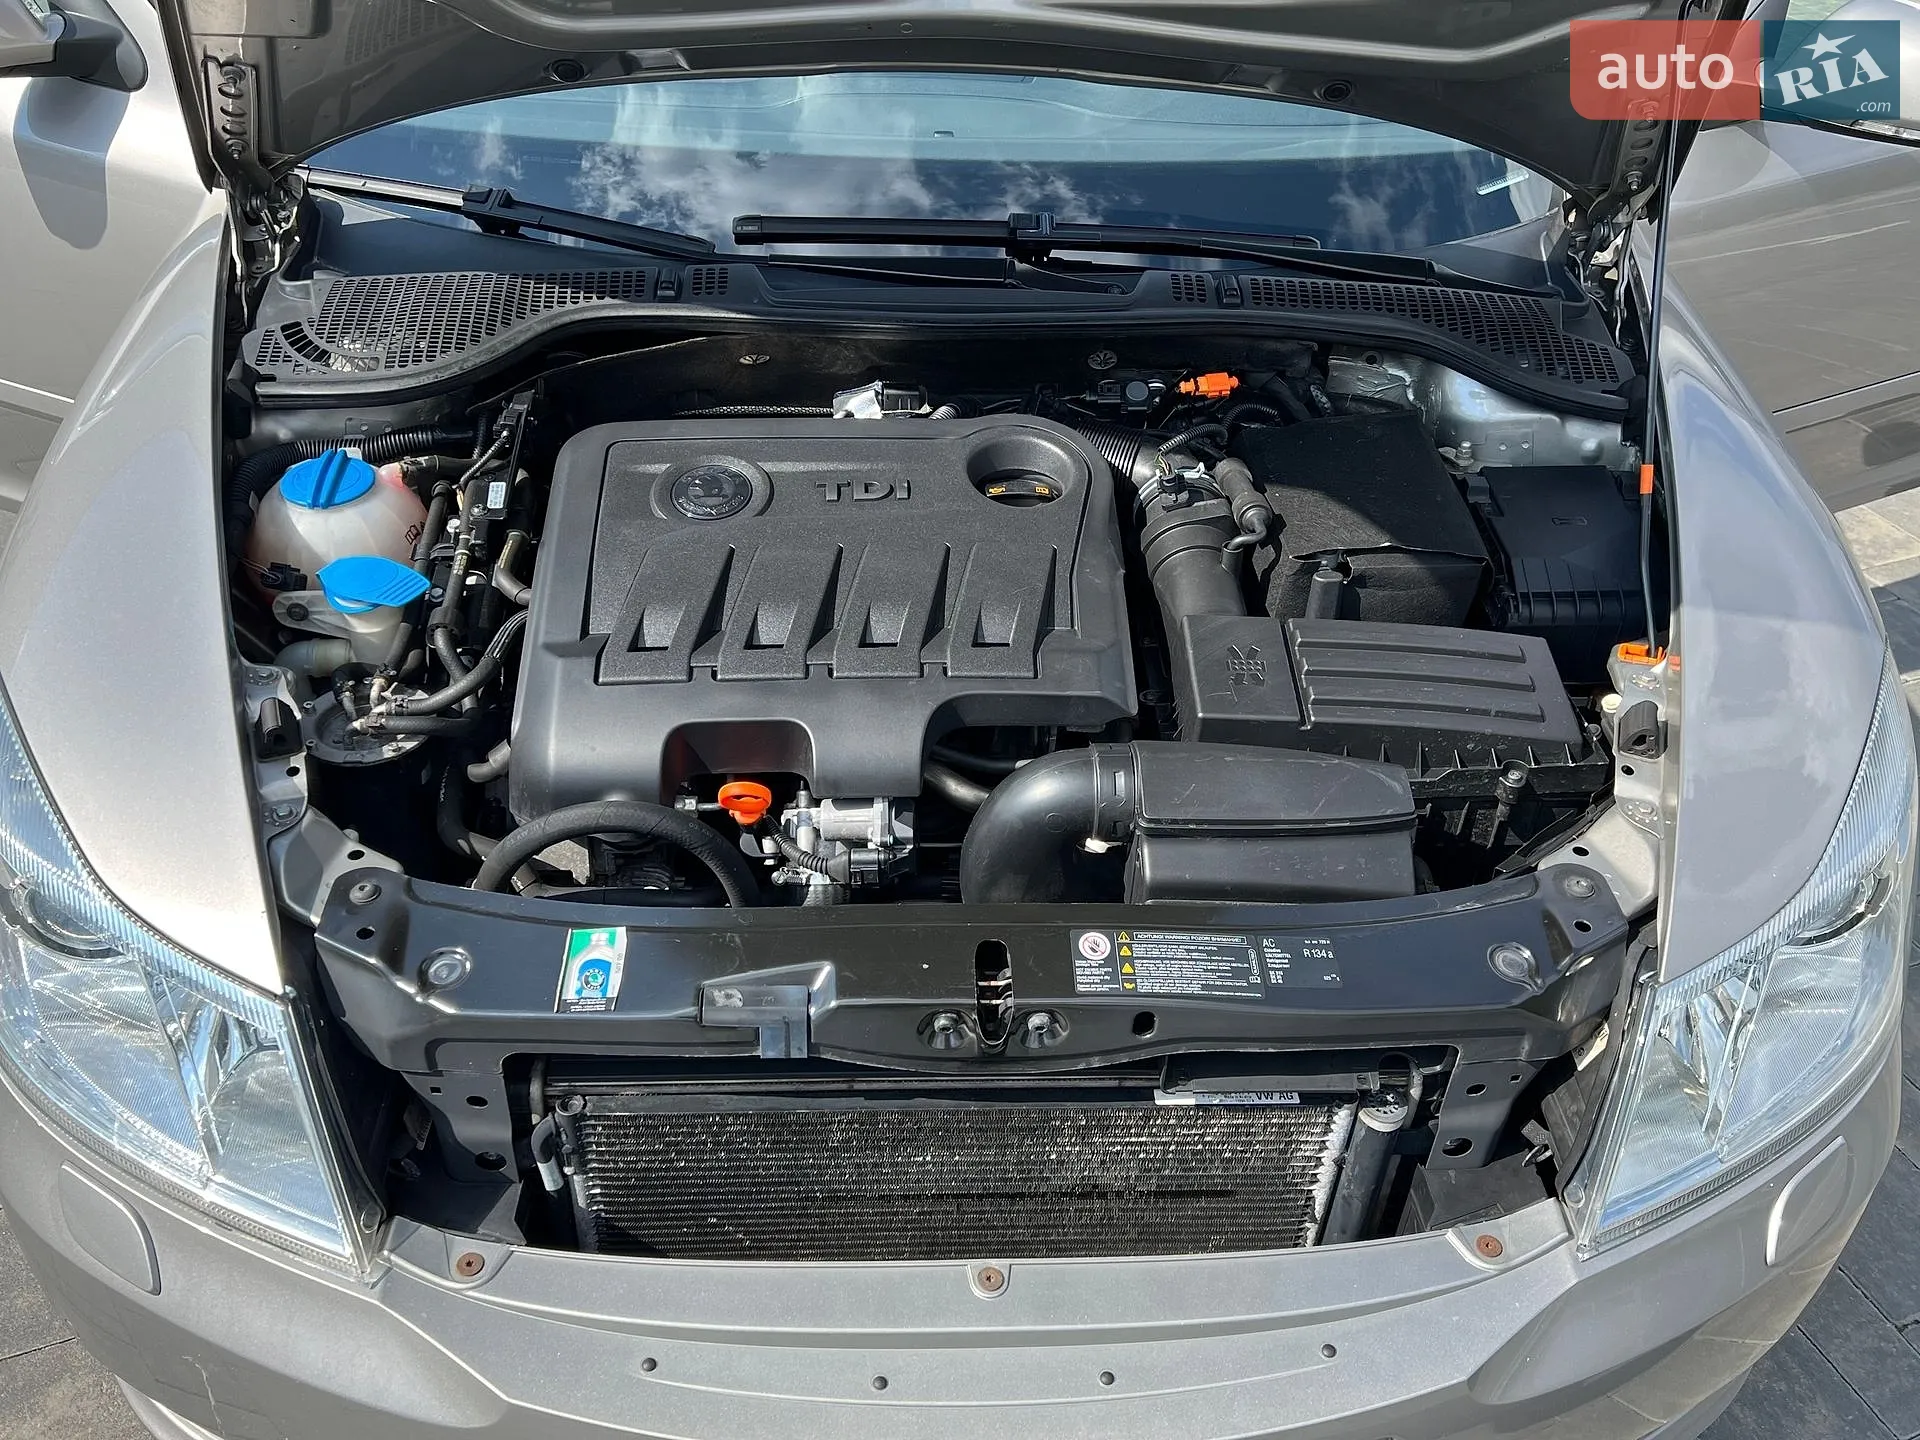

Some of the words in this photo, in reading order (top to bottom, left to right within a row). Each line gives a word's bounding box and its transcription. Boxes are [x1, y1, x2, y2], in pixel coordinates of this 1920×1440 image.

[815, 479, 911, 502] TDI
[1262, 938, 1276, 948] AC
[1255, 1092, 1274, 1101] VW
[1278, 1092, 1294, 1101] AG
